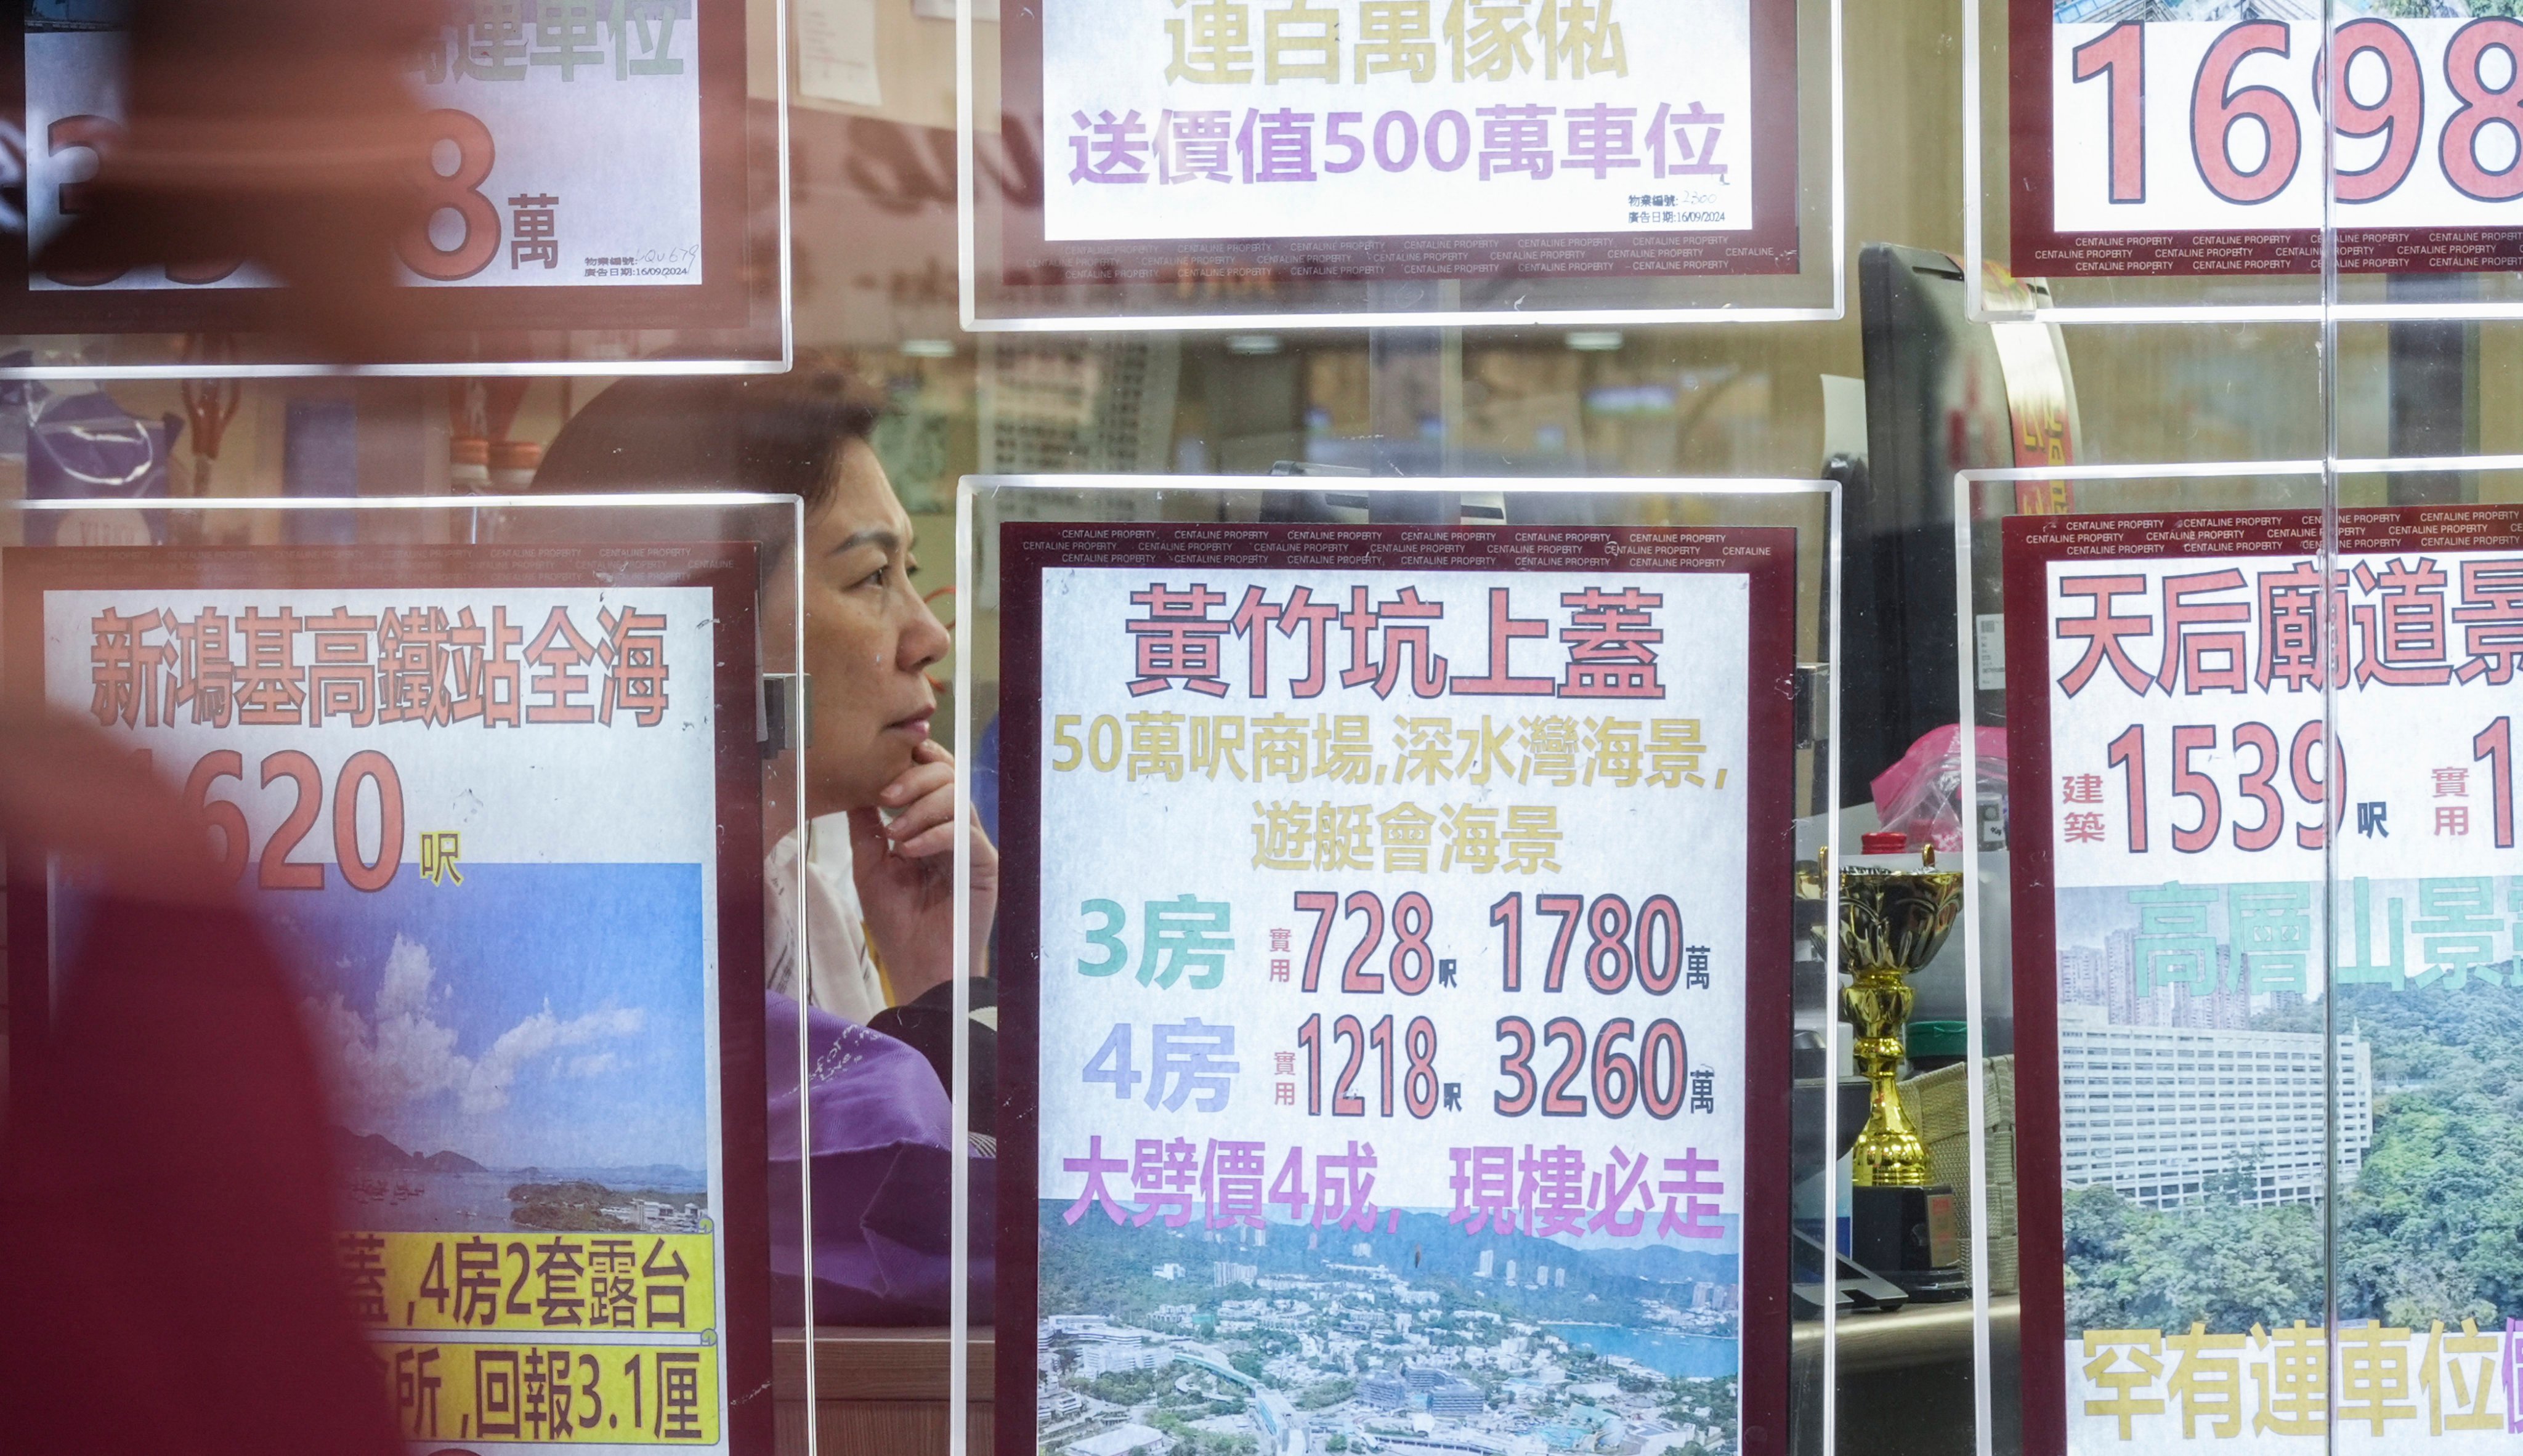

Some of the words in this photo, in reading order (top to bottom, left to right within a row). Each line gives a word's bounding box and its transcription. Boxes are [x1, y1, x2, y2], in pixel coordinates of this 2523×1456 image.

[2072, 17, 2523, 204] 1698
[1068, 102, 1730, 185] 送價值500萬車位
[1178, 244, 1226, 253] CENTALINE
[1228, 243, 1274, 252] PROPERTY
[1290, 242, 1339, 251] CENTALINE
[1342, 241, 1387, 250] PROPERTY
[1404, 240, 1452, 249] CENTALINE
[1455, 240, 1500, 248] PROPERTY
[1518, 239, 1566, 248] CENTALINE
[1568, 238, 1614, 247] PROPERTY
[1632, 237, 1680, 246] CENTALINE
[1683, 237, 1728, 245] PROPERTY
[2075, 238, 2124, 246] CENTALINE
[2126, 237, 2173, 246] PROPERTY
[2193, 237, 2242, 245] CENTALINE
[2245, 236, 2290, 245] PROPERTY
[2362, 234, 2408, 243] PROPERTY
[2429, 233, 2477, 242] CENTALINE
[1141, 257, 1189, 266] CENTALINE
[1191, 256, 1237, 265] PROPERTY
[1257, 255, 1305, 264] CENTALINE
[1307, 254, 1353, 263] PROPERTY
[1372, 253, 1421, 262] CENTALINE
[1423, 253, 1468, 261] PROPERTY
[1489, 251, 1538, 260] CENTALINE
[1541, 251, 1585, 259] PROPERTY
[1606, 249, 1655, 258] CENTALINE
[1658, 248, 1703, 257] PROPERTY
[1725, 247, 1773, 256] CENTALINE
[2035, 250, 2084, 259] CENTALINE
[2087, 249, 2132, 258] PROPERTY
[2155, 249, 2204, 257] CENTALINE
[2206, 248, 2253, 257] PROPERTY
[2397, 246, 2446, 255] CENTALINE
[2449, 246, 2495, 254] PROPERTY
[1178, 269, 1226, 277] CENTALINE
[1228, 268, 1274, 277] PROPERTY
[1290, 267, 1339, 275] CENTALINE
[1342, 266, 1387, 275] PROPERTY
[1404, 265, 1452, 273] CENTALINE
[1455, 264, 1500, 273] PROPERTY
[1518, 263, 1566, 272] CENTALINE
[1568, 262, 1614, 271] PROPERTY
[1632, 261, 1680, 270] CENTALINE
[1683, 260, 1728, 269] PROPERTY
[2075, 262, 2124, 270] CENTALINE
[2127, 261, 2173, 270] PROPERTY
[2193, 261, 2242, 269] CENTALINE
[2245, 260, 2291, 269] PROPERTY
[2362, 258, 2408, 267] PROPERTY
[2429, 257, 2478, 266] CENTALINE
[2066, 521, 2115, 530] CENTALINE
[2119, 520, 2165, 529] PROPERTY
[2184, 518, 2233, 527] CENTALINE
[2236, 517, 2282, 526] PROPERTY
[2354, 514, 2400, 523] PROPERTY
[2421, 512, 2469, 521] CENTALINE
[2472, 511, 2518, 520] PROPERTY
[1062, 530, 1109, 538] CENTALINE
[1111, 530, 1157, 538] PROPERTY
[1174, 530, 1221, 539] CENTALINE
[1225, 531, 1270, 540] PROPERTY
[1287, 532, 1334, 540] CENTALINE
[1337, 532, 1382, 540] PROPERTY
[1401, 532, 1448, 541] CENTALINE
[1451, 533, 1496, 541] PROPERTY
[1515, 533, 1562, 541] CENTALINE
[1565, 533, 1610, 542] PROPERTY
[1630, 534, 1677, 543] CENTALINE
[1680, 535, 1725, 543] PROPERTY
[2027, 534, 2075, 544] CENTALINE
[2078, 533, 2124, 543] PROPERTY
[2146, 531, 2195, 541] CENTALINE
[2198, 530, 2243, 540] PROPERTY
[2267, 528, 2315, 538] CENTALINE
[2389, 525, 2437, 535] CENTALINE
[2440, 524, 2486, 533] PROPERTY
[1023, 542, 1070, 550] CENTALINE
[1073, 542, 1118, 551] PROPERTY
[1138, 543, 1185, 551] CENTALINE
[1188, 543, 1233, 551] PROPERTY
[1254, 543, 1301, 552] CENTALINE
[1303, 544, 1349, 552] PROPERTY
[1370, 544, 1417, 553] CENTALINE
[1420, 544, 1465, 553] PROPERTY
[1487, 545, 1534, 554] CENTALINE
[1537, 546, 1582, 554] PROPERTY
[1604, 546, 1651, 555] CENTALINE
[1654, 546, 1699, 555] PROPERTY
[1723, 547, 1770, 556] CENTALINE
[2067, 545, 2116, 555] CENTALINE
[2119, 544, 2165, 554] PROPERTY
[2185, 542, 2234, 552] CENTALINE
[2237, 541, 2283, 551] PROPERTY
[2355, 538, 2401, 548] PROPERTY
[2421, 536, 2470, 546] CENTALINE
[2474, 535, 2519, 545] PROPERTY
[1062, 554, 1109, 563] CENTALINE
[1111, 555, 1157, 563] PROPERTY
[1174, 555, 1221, 564] CENTALINE
[1225, 556, 1270, 564] PROPERTY
[1287, 556, 1334, 564] CENTALINE
[1337, 556, 1382, 565] PROPERTY
[1401, 557, 1448, 565] CENTALINE
[1451, 557, 1496, 565] PROPERTY
[1515, 557, 1562, 566] CENTALINE
[1565, 558, 1610, 566] PROPERTY
[1630, 558, 1677, 567] CENTALINE
[1680, 559, 1725, 567] PROPERTY
[1125, 582, 1665, 699] 黃竹坑上蓋
[90, 605, 670, 730] 新鴻基高鐵站全海
[2062, 773, 2106, 843] 建築
[2431, 767, 2469, 836] 實用
[1250, 799, 1564, 875] 遊艇會海景
[1077, 893, 1235, 990] 3房
[2128, 876, 2523, 997] 高層山景
[1081, 1017, 1241, 1115] 4房
